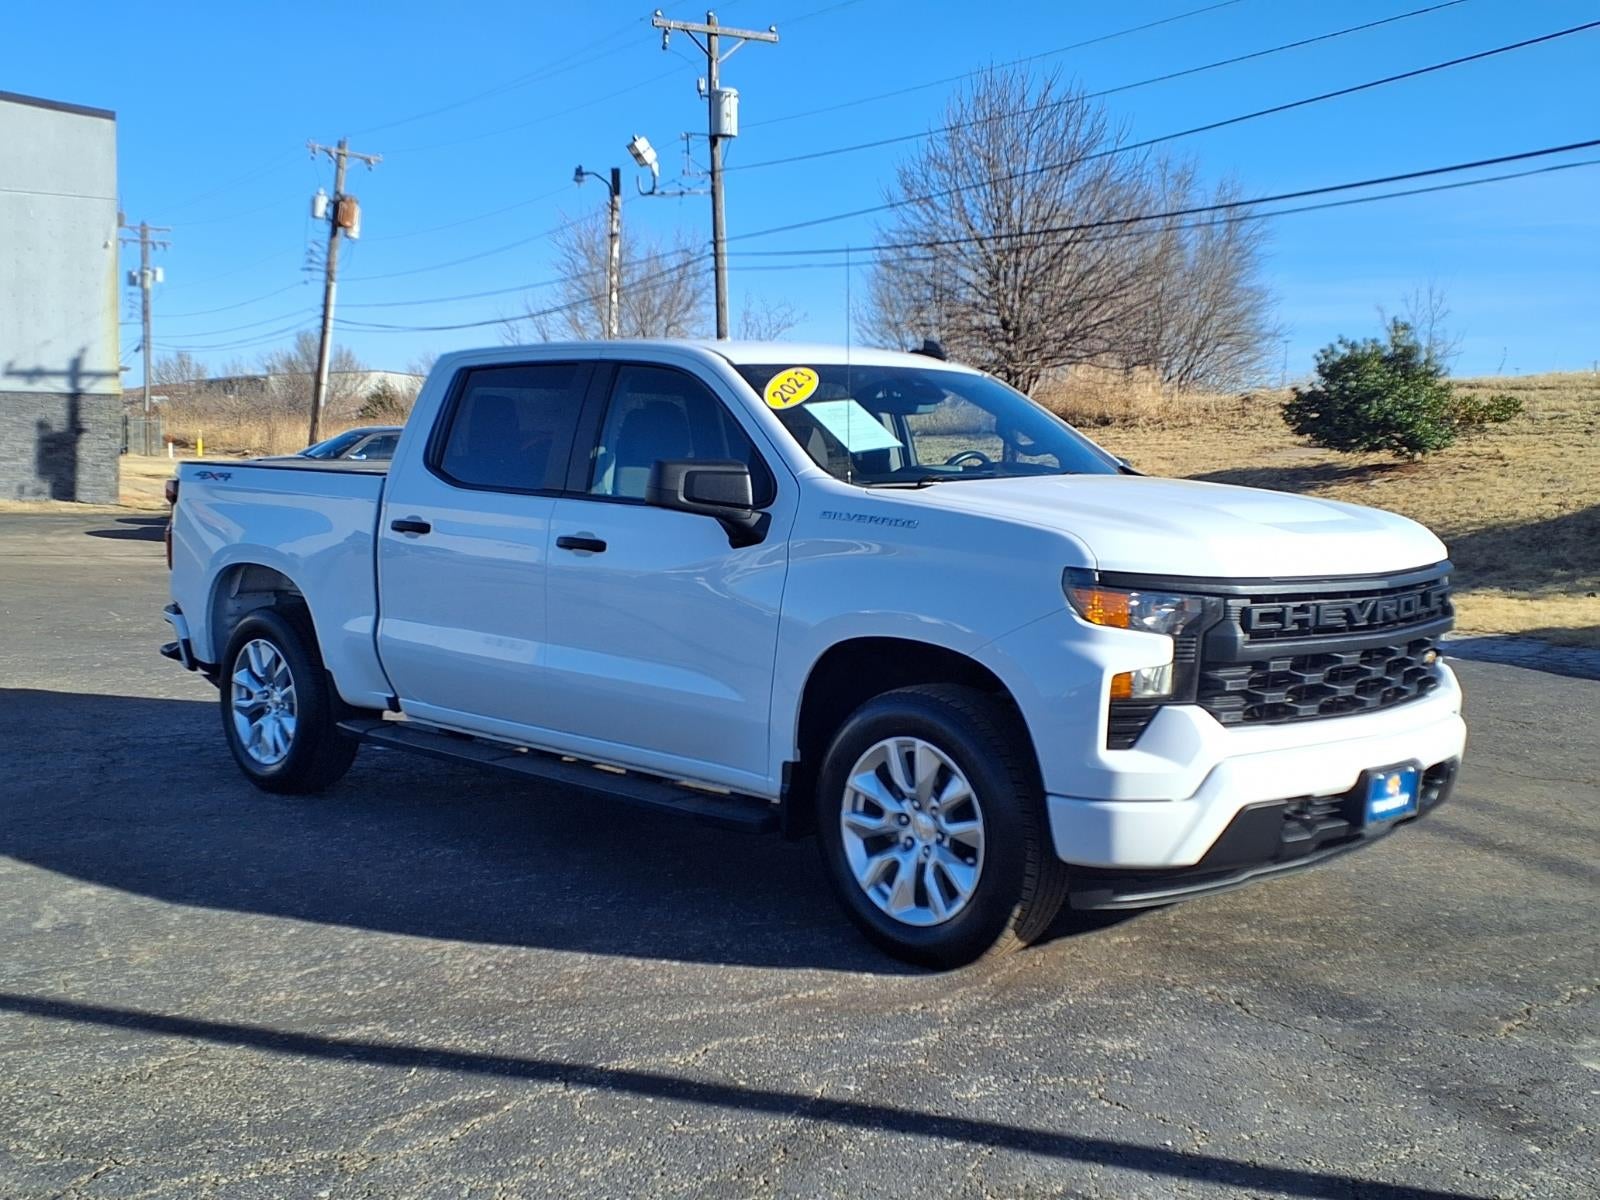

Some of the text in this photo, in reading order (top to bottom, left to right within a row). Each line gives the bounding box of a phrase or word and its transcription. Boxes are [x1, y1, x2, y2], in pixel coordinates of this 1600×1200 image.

[772, 371, 812, 403] 2023
[820, 510, 919, 529] SILVERADO
[1251, 587, 1448, 631] CHEVROLE
